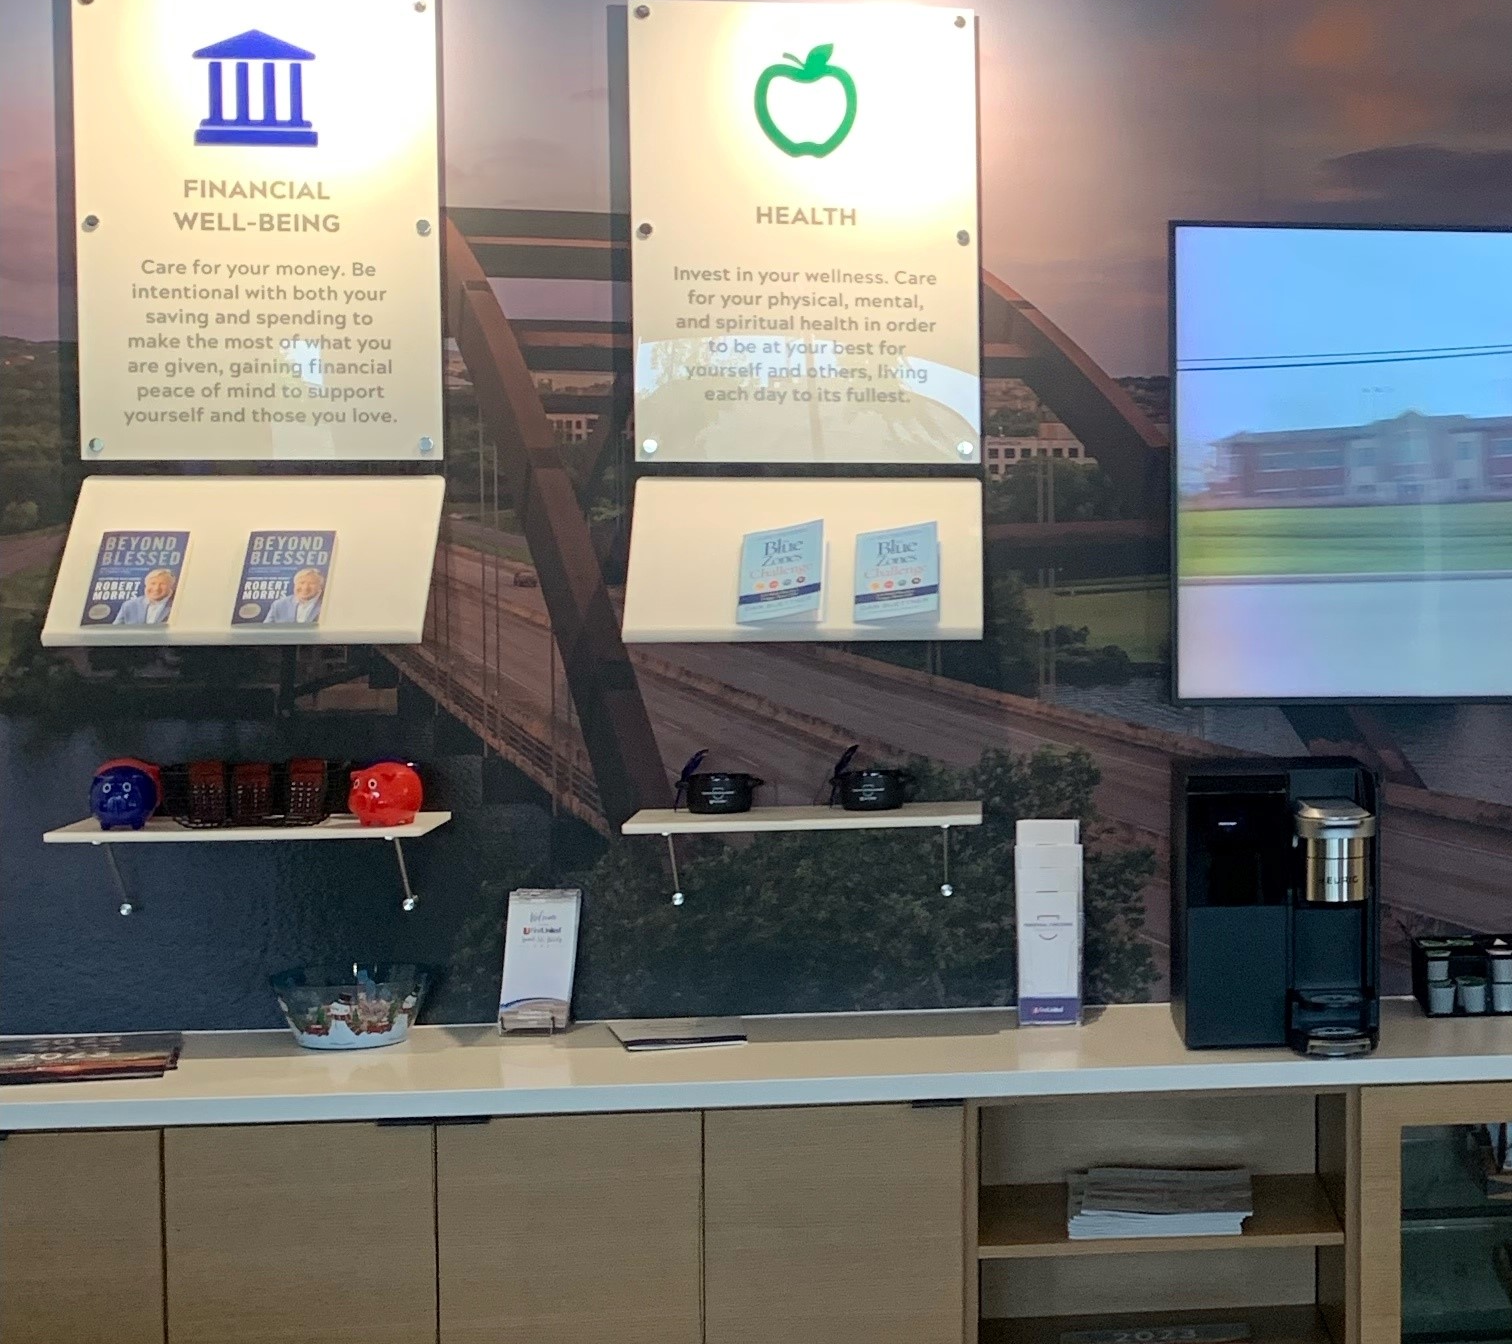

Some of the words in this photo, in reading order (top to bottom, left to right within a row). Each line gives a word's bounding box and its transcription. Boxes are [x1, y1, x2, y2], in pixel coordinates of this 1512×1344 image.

[184, 180, 330, 200] FINANCIAL
[173, 212, 339, 231] WELL-BEING
[757, 206, 856, 225] HEALTH
[141, 260, 187, 274] Care
[192, 259, 221, 275] for
[227, 264, 270, 279] your
[276, 265, 345, 280] money.
[352, 262, 376, 276] Be
[674, 266, 730, 281] Invest
[737, 267, 753, 281] in
[758, 271, 800, 285] your
[805, 269, 888, 284] wellness.
[895, 271, 936, 285] Care
[132, 284, 239, 300] intentional
[245, 285, 286, 300] with
[293, 285, 338, 301] both
[343, 290, 387, 304] your
[688, 290, 715, 305] for
[720, 295, 762, 309] your
[768, 292, 848, 310] physical,
[855, 294, 923, 311] mental,
[146, 308, 208, 329] saving
[215, 309, 250, 324] and
[257, 310, 346, 330] spending
[353, 312, 373, 325] to
[676, 313, 710, 329] and
[715, 315, 794, 331] spiritual
[800, 316, 858, 331] health
[864, 316, 881, 331] in
[886, 318, 936, 332] order
[128, 333, 181, 348] make
[186, 333, 218, 349] the
[225, 336, 273, 349] most
[279, 333, 300, 350] of
[304, 334, 352, 350] what
[357, 339, 391, 354] you
[709, 339, 728, 353] to
[734, 340, 756, 354] be
[763, 341, 781, 353] at
[785, 341, 827, 356] your
[832, 340, 874, 355] best
[879, 340, 906, 356] for
[128, 361, 159, 373] are
[165, 358, 223, 377] given,
[229, 359, 302, 378] gaining
[309, 358, 392, 374] financial
[686, 362, 762, 381] yourself
[768, 363, 801, 378] and
[806, 362, 872, 381] others,
[878, 363, 927, 383] living
[137, 386, 195, 401] peace
[201, 382, 221, 398] of
[227, 383, 276, 398] mind
[282, 384, 302, 398] to
[308, 386, 384, 402] support
[704, 386, 748, 401] each
[754, 386, 788, 405] day
[792, 388, 813, 402] to
[816, 387, 841, 402] its
[846, 387, 910, 403] fullest.
[124, 407, 204, 426] yourself
[210, 407, 245, 423] and
[251, 407, 306, 423] those
[312, 411, 346, 426] you
[353, 408, 397, 423] love.
[105, 536, 177, 551] BEYOND
[253, 536, 324, 551] BEYOND
[102, 551, 181, 566] BLESSED
[250, 551, 329, 566] BLESSED
[93, 590, 138, 601] MORRIS
[95, 581, 141, 591] ROBERT
[242, 590, 287, 600] MORRIS
[244, 581, 290, 591] ROBERT
